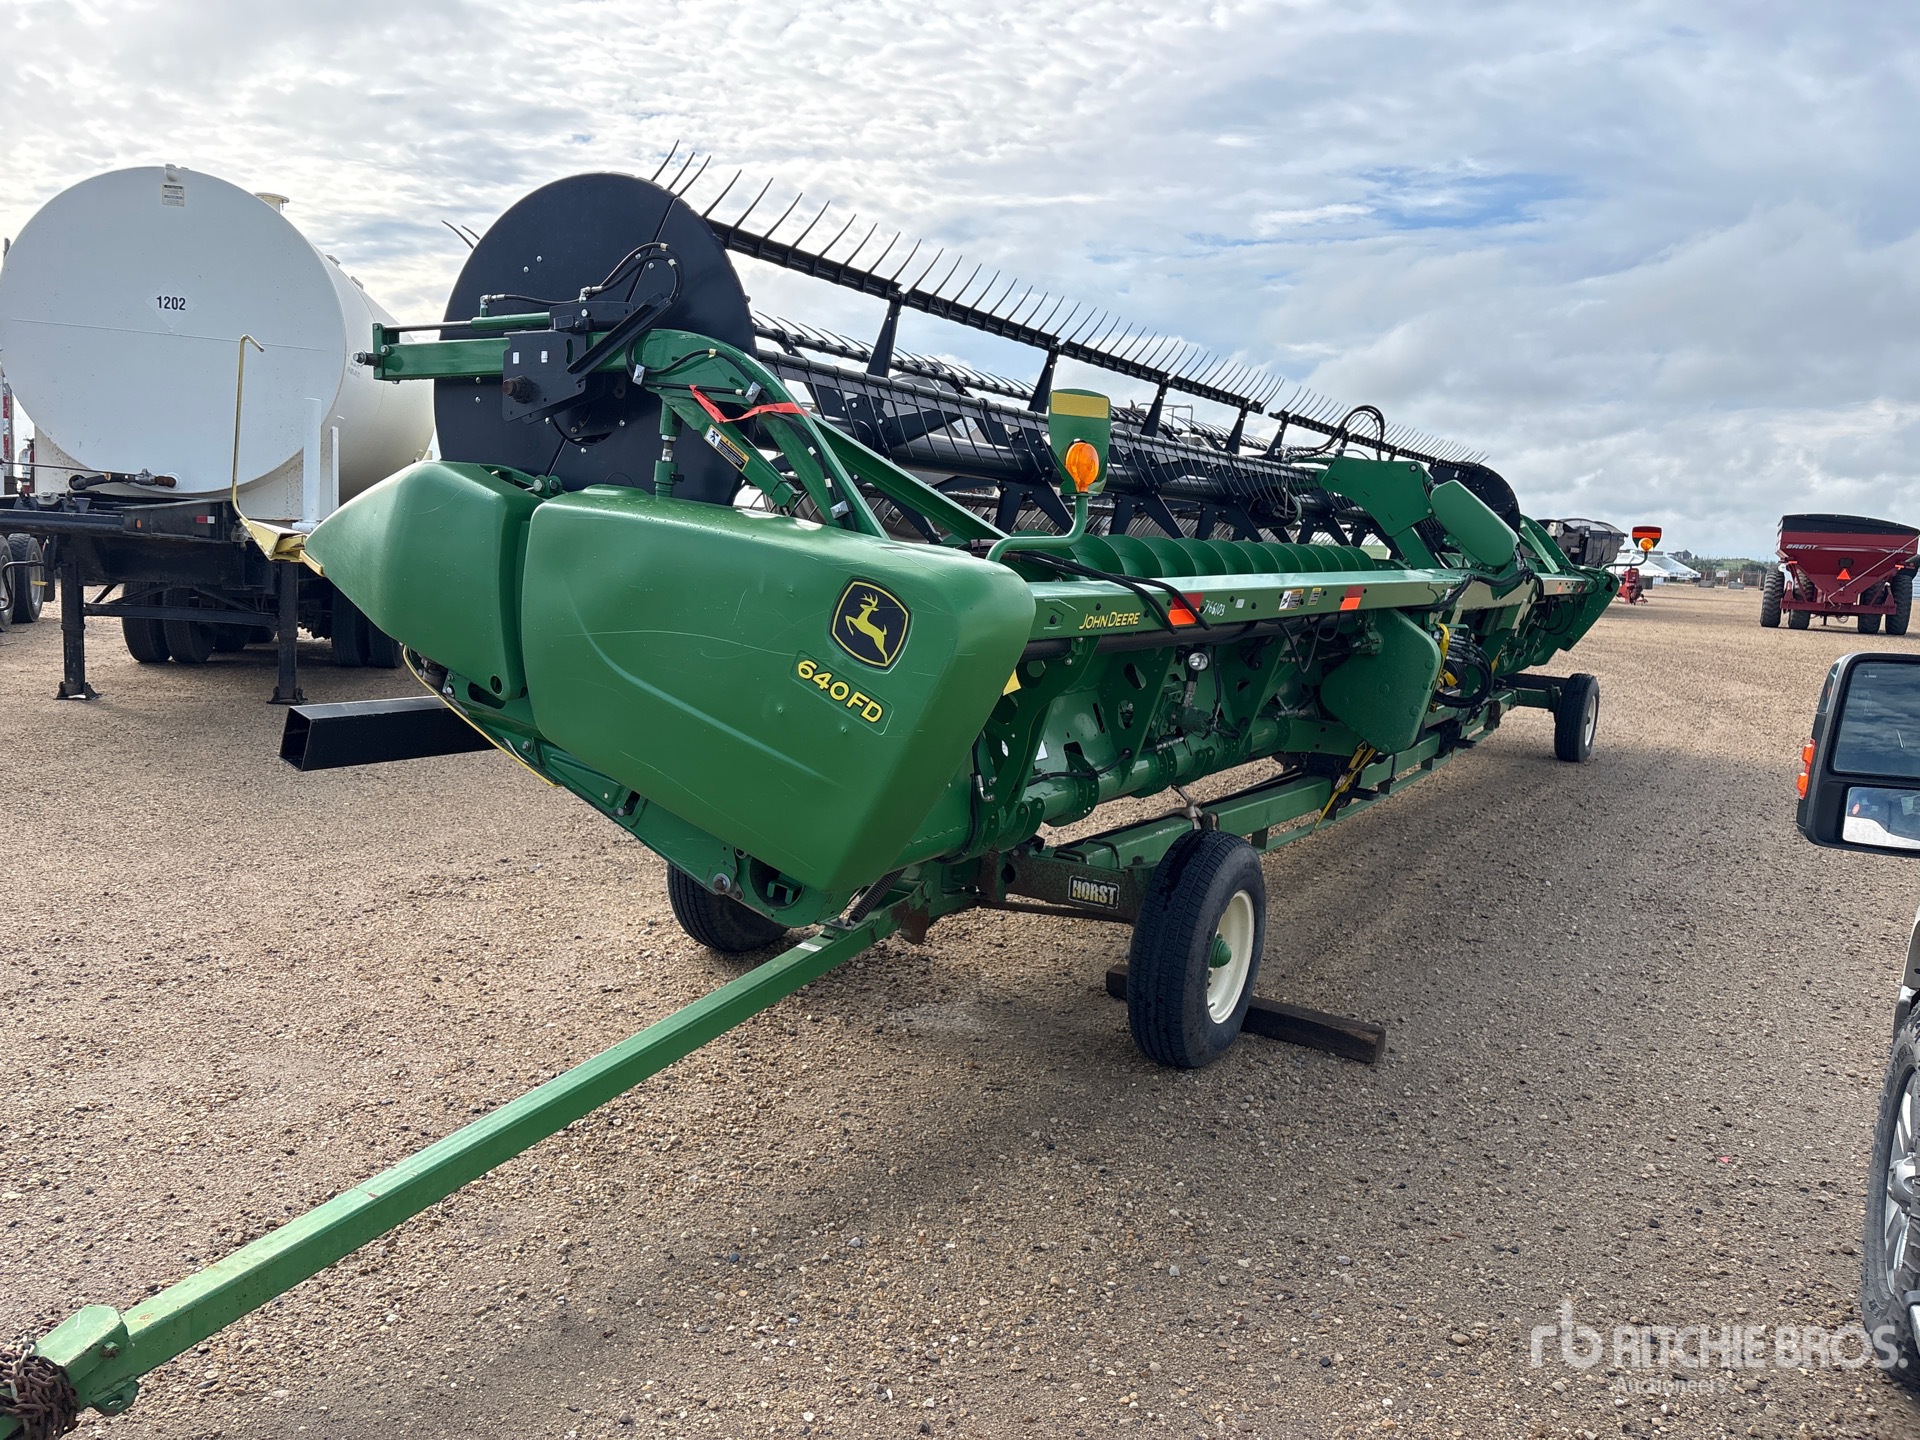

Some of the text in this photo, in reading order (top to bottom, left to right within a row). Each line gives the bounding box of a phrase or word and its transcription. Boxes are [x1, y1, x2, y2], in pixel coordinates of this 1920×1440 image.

[156, 295, 186, 311] 1202
[1078, 611, 1141, 630] JOHN DEERE
[797, 660, 884, 723] 640FD
[1072, 879, 1117, 905] HORST
